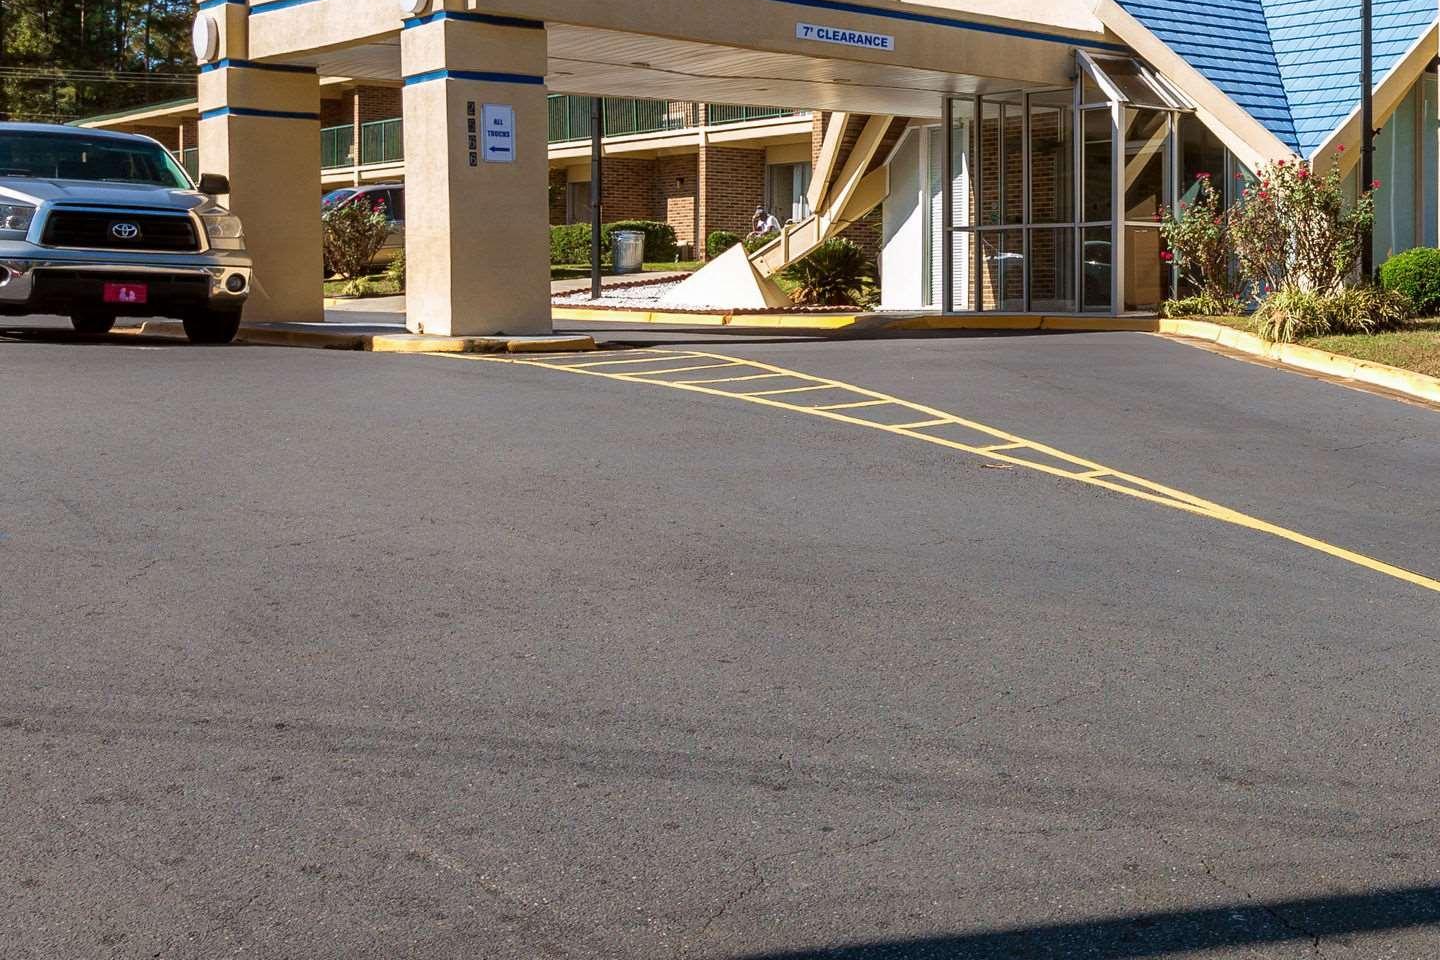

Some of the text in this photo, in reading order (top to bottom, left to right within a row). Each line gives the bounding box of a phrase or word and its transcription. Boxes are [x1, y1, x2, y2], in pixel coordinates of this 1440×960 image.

[816, 28, 889, 48] CLEARANCE
[493, 118, 504, 126] ALL
[487, 130, 511, 138] TRUCKS
